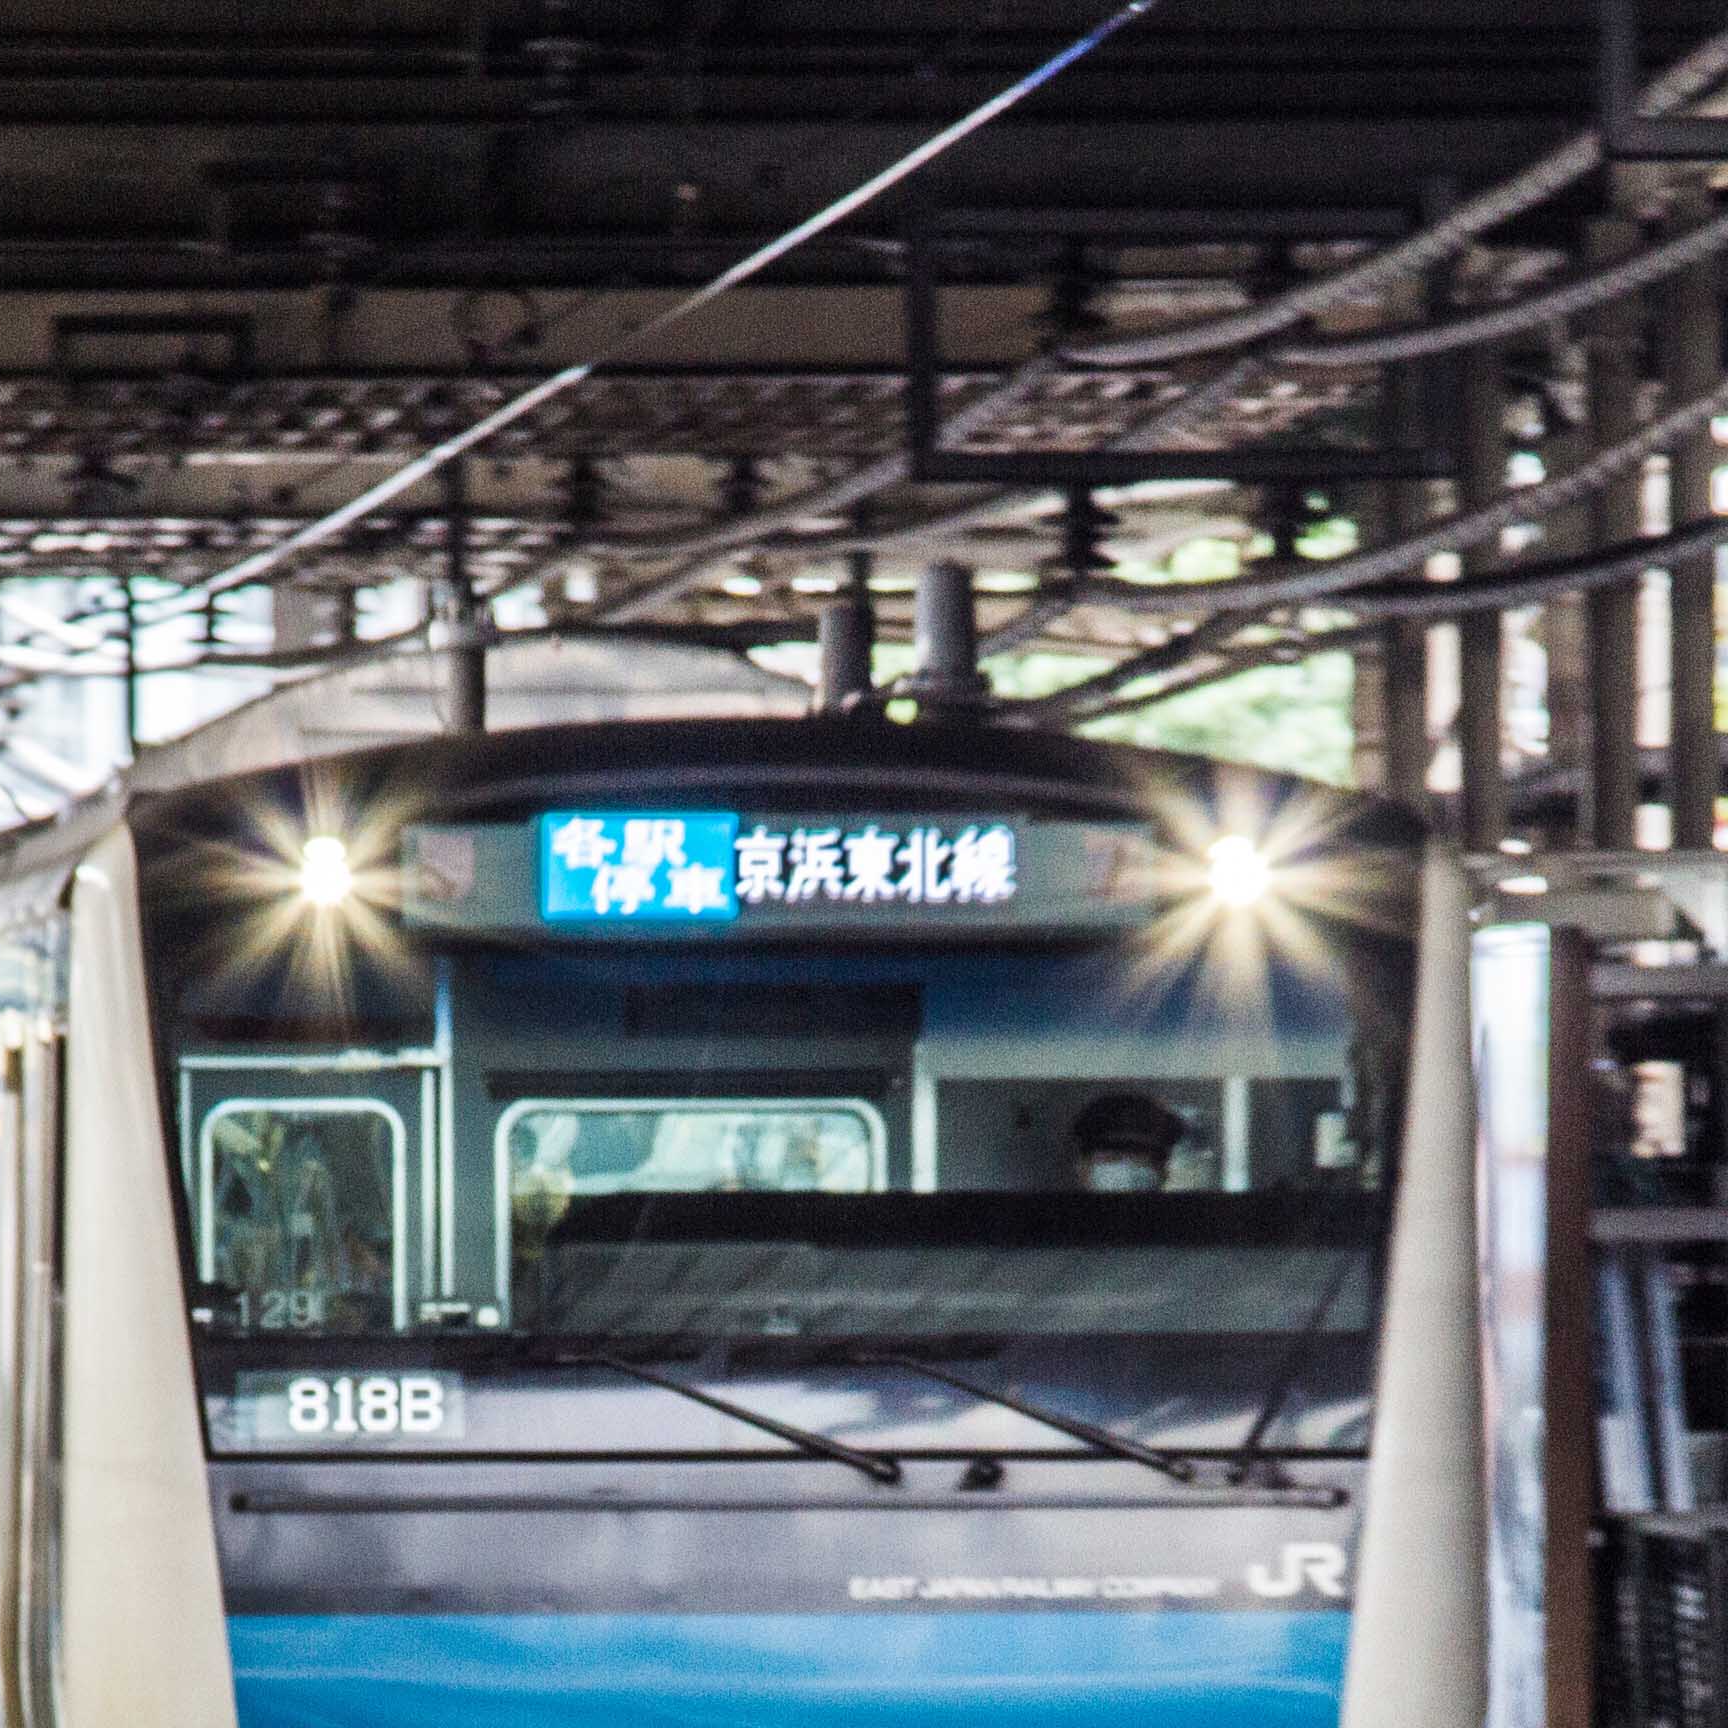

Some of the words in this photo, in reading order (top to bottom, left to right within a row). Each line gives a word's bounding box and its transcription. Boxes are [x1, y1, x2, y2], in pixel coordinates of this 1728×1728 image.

[551, 816, 687, 868] 各駅
[734, 824, 1018, 903] 京浜東北線
[591, 861, 729, 916] 停車
[288, 1376, 443, 1433] 818B
[1246, 1542, 1346, 1598] JR
